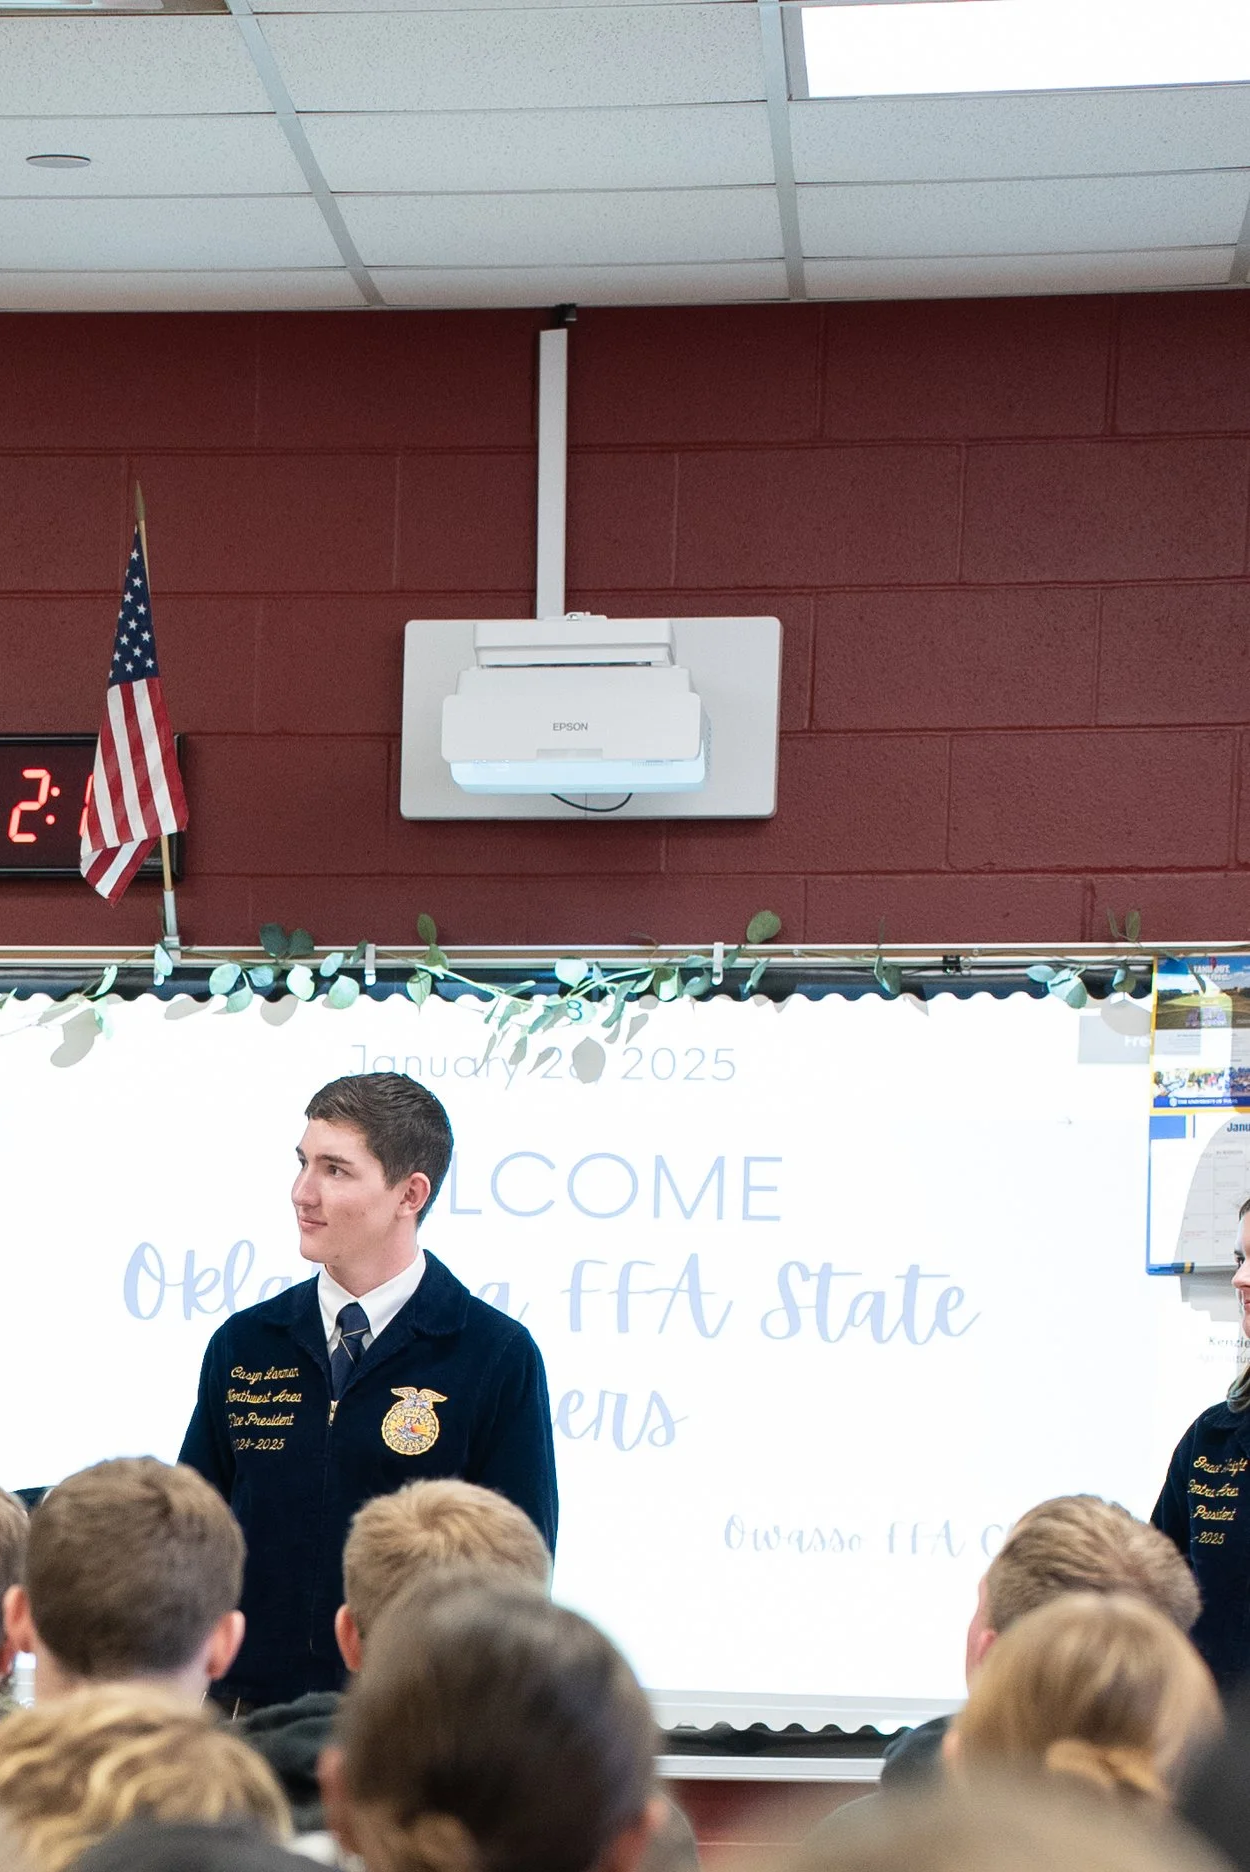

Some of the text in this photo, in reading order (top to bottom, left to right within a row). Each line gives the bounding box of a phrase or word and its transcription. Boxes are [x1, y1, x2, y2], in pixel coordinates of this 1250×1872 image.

[552, 721, 589, 732] EPSON
[349, 1044, 519, 1091] January
[620, 1046, 737, 1082] 2025
[448, 1151, 784, 1222] LCOME
[559, 1252, 734, 1339] FFA
[760, 1259, 982, 1345] State
[225, 1388, 303, 1404] Northwest Area
[244, 1411, 295, 1427] President
[885, 1519, 967, 1559] FFA
